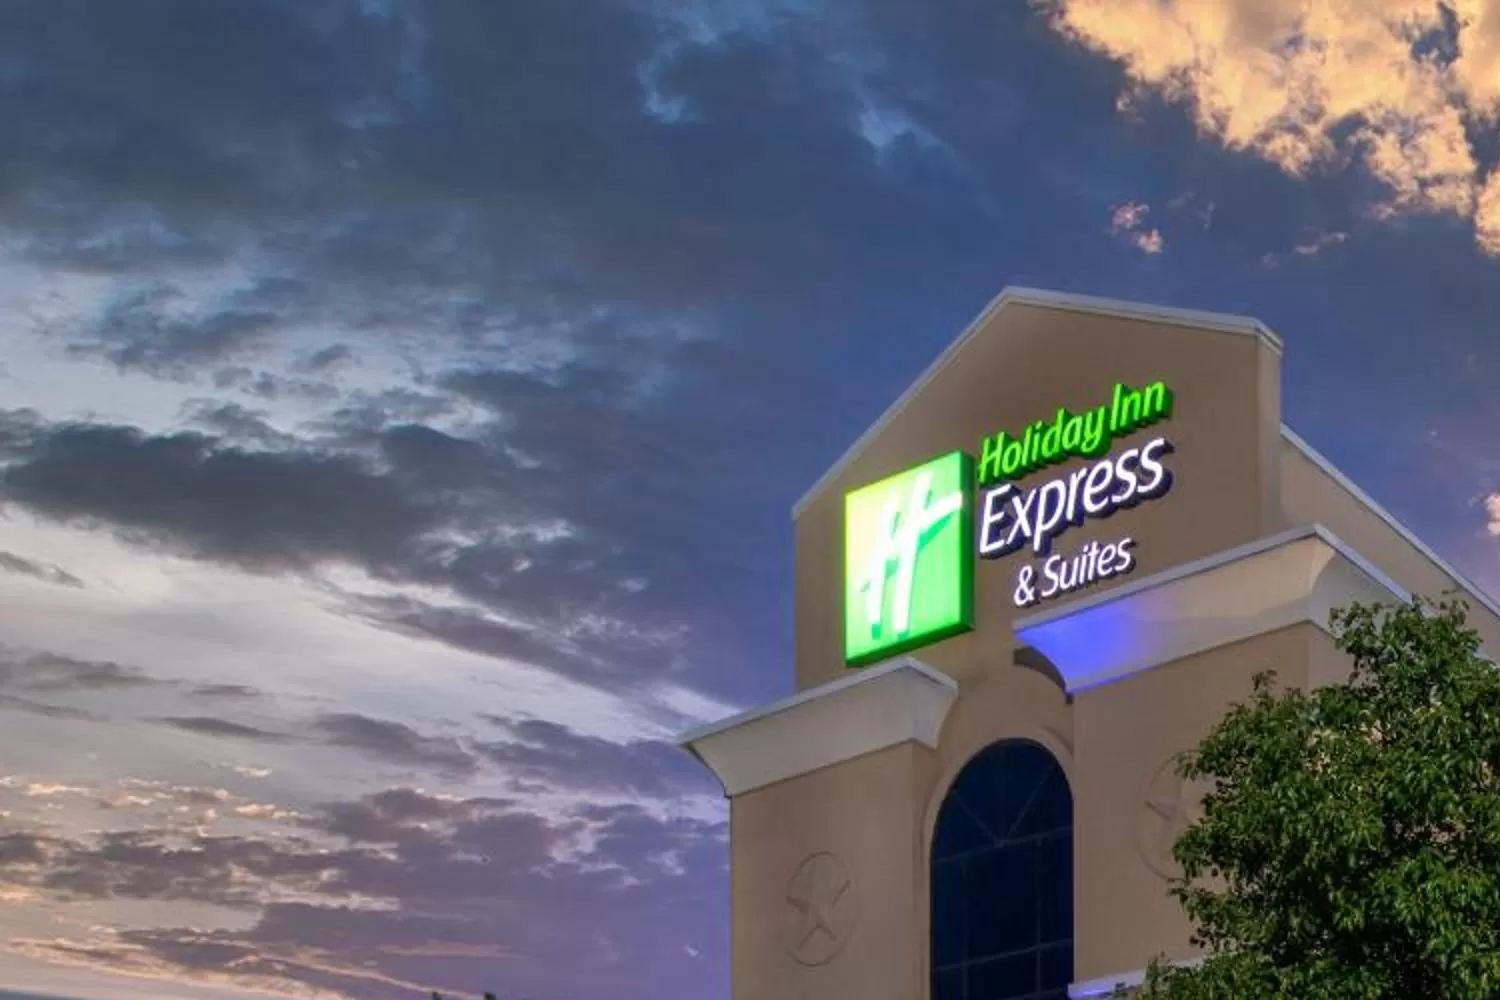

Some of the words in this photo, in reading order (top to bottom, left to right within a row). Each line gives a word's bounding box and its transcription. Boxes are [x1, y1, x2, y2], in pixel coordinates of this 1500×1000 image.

[979, 406, 1108, 484] Holiday
[1108, 381, 1171, 432] Inn
[979, 437, 1172, 556] Express
[1013, 565, 1037, 606] &
[1041, 538, 1134, 598] Suites
